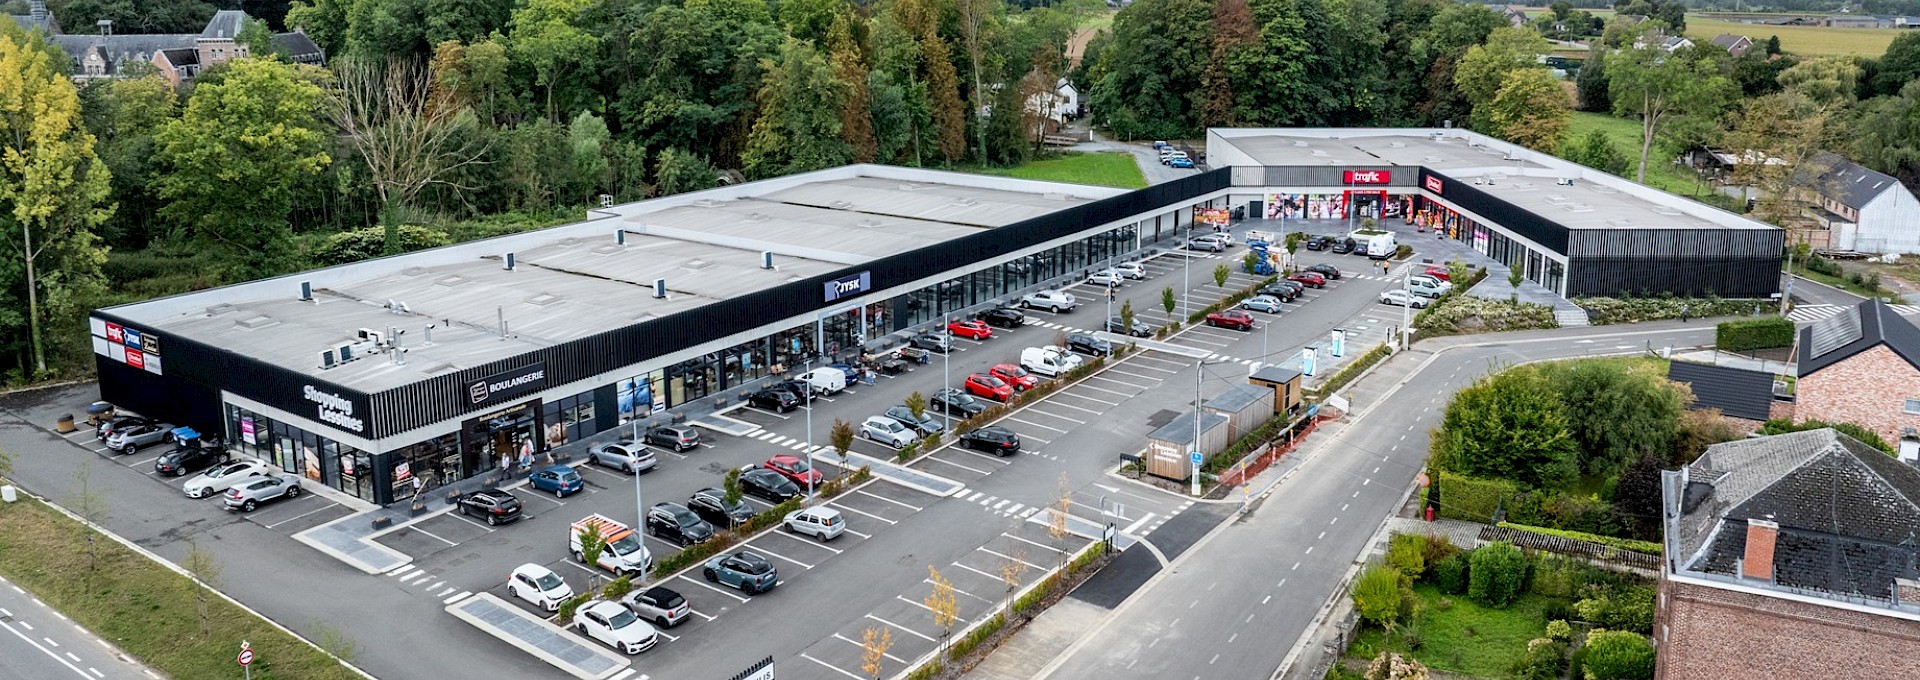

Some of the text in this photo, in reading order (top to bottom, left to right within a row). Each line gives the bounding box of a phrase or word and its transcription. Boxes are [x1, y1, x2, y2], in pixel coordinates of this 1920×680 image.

[1354, 171, 1380, 183] trafic
[840, 279, 860, 293] JYSK
[489, 370, 545, 393] BOULANGERIE
[303, 384, 353, 416] Shopping
[318, 404, 364, 432] Lessines
